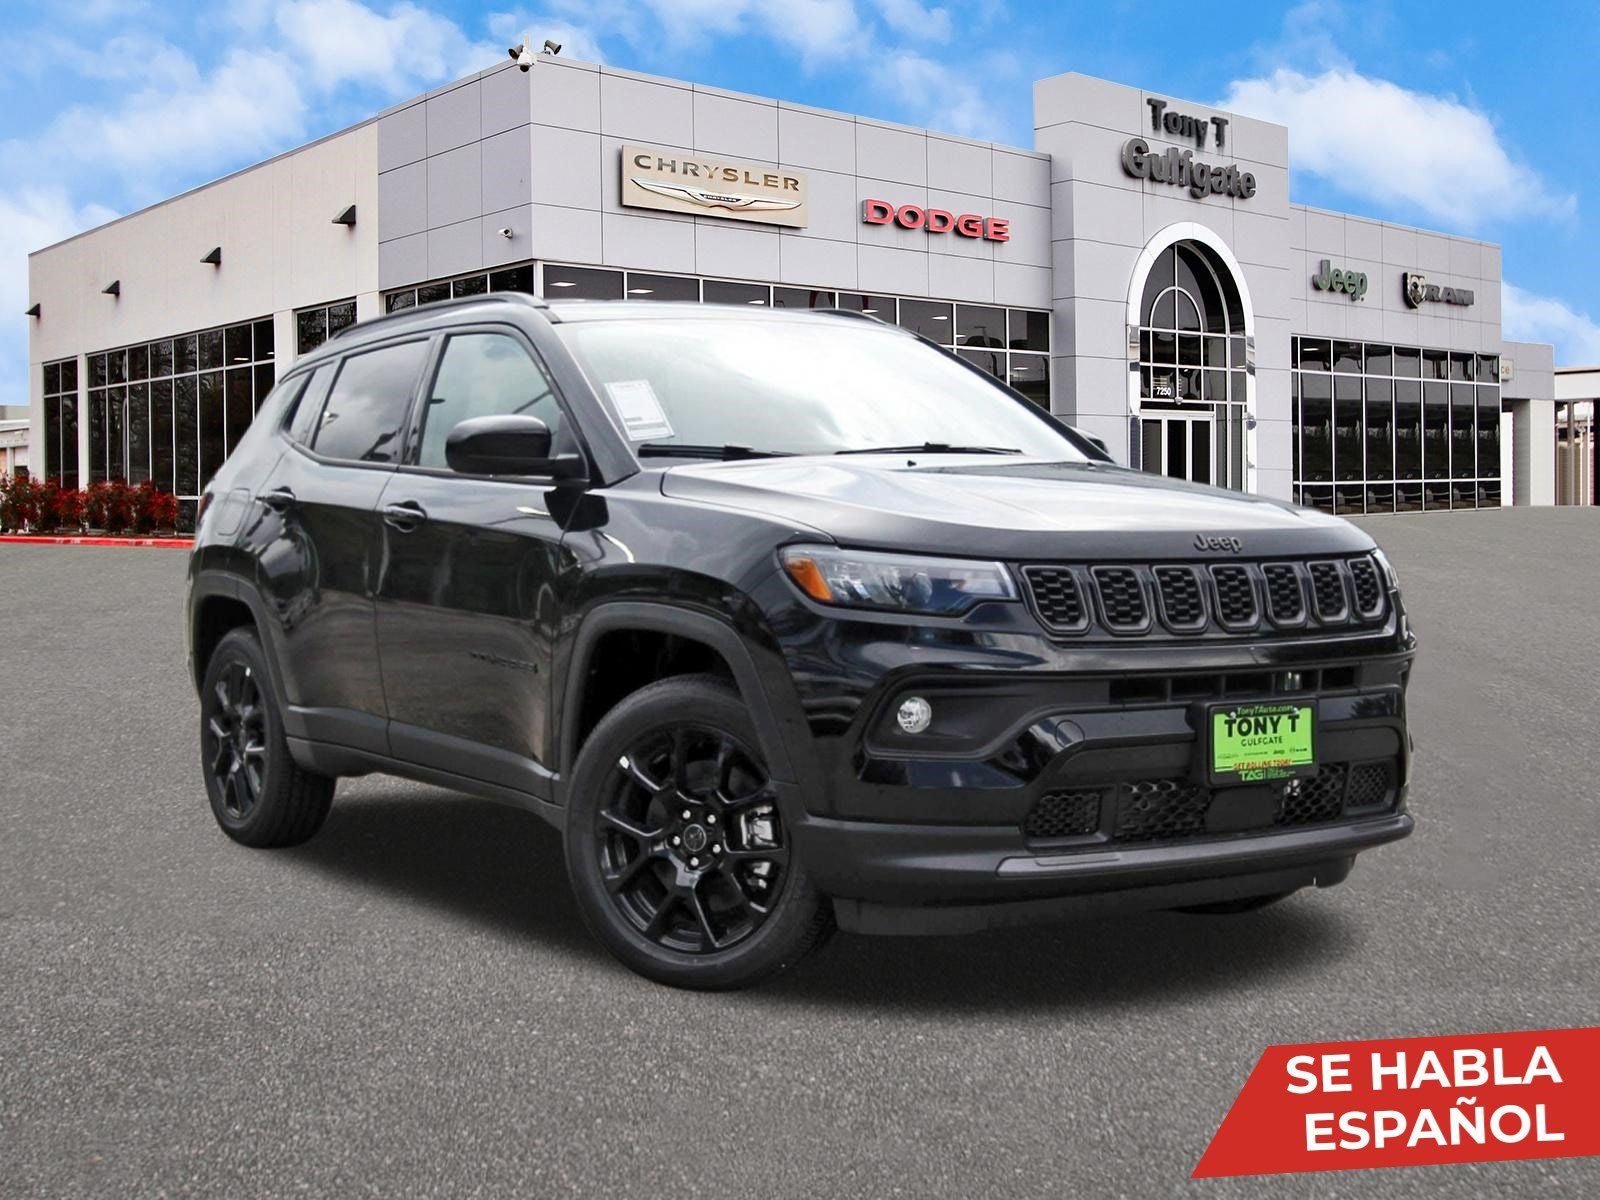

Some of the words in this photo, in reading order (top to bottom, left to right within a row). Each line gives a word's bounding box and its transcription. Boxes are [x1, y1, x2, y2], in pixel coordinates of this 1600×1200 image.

[1146, 97, 1208, 148] Tony
[1210, 116, 1229, 147] T
[633, 154, 801, 192] CHRYSLER
[1121, 137, 1257, 199] Gulfgate
[862, 198, 1011, 243] DODGE
[1312, 259, 1368, 300] Jeep
[1424, 283, 1475, 307] RAM
[1156, 386, 1172, 396] 7250
[1193, 533, 1243, 554] Jeep
[1224, 716, 1281, 737] TONY
[1287, 714, 1300, 733] T
